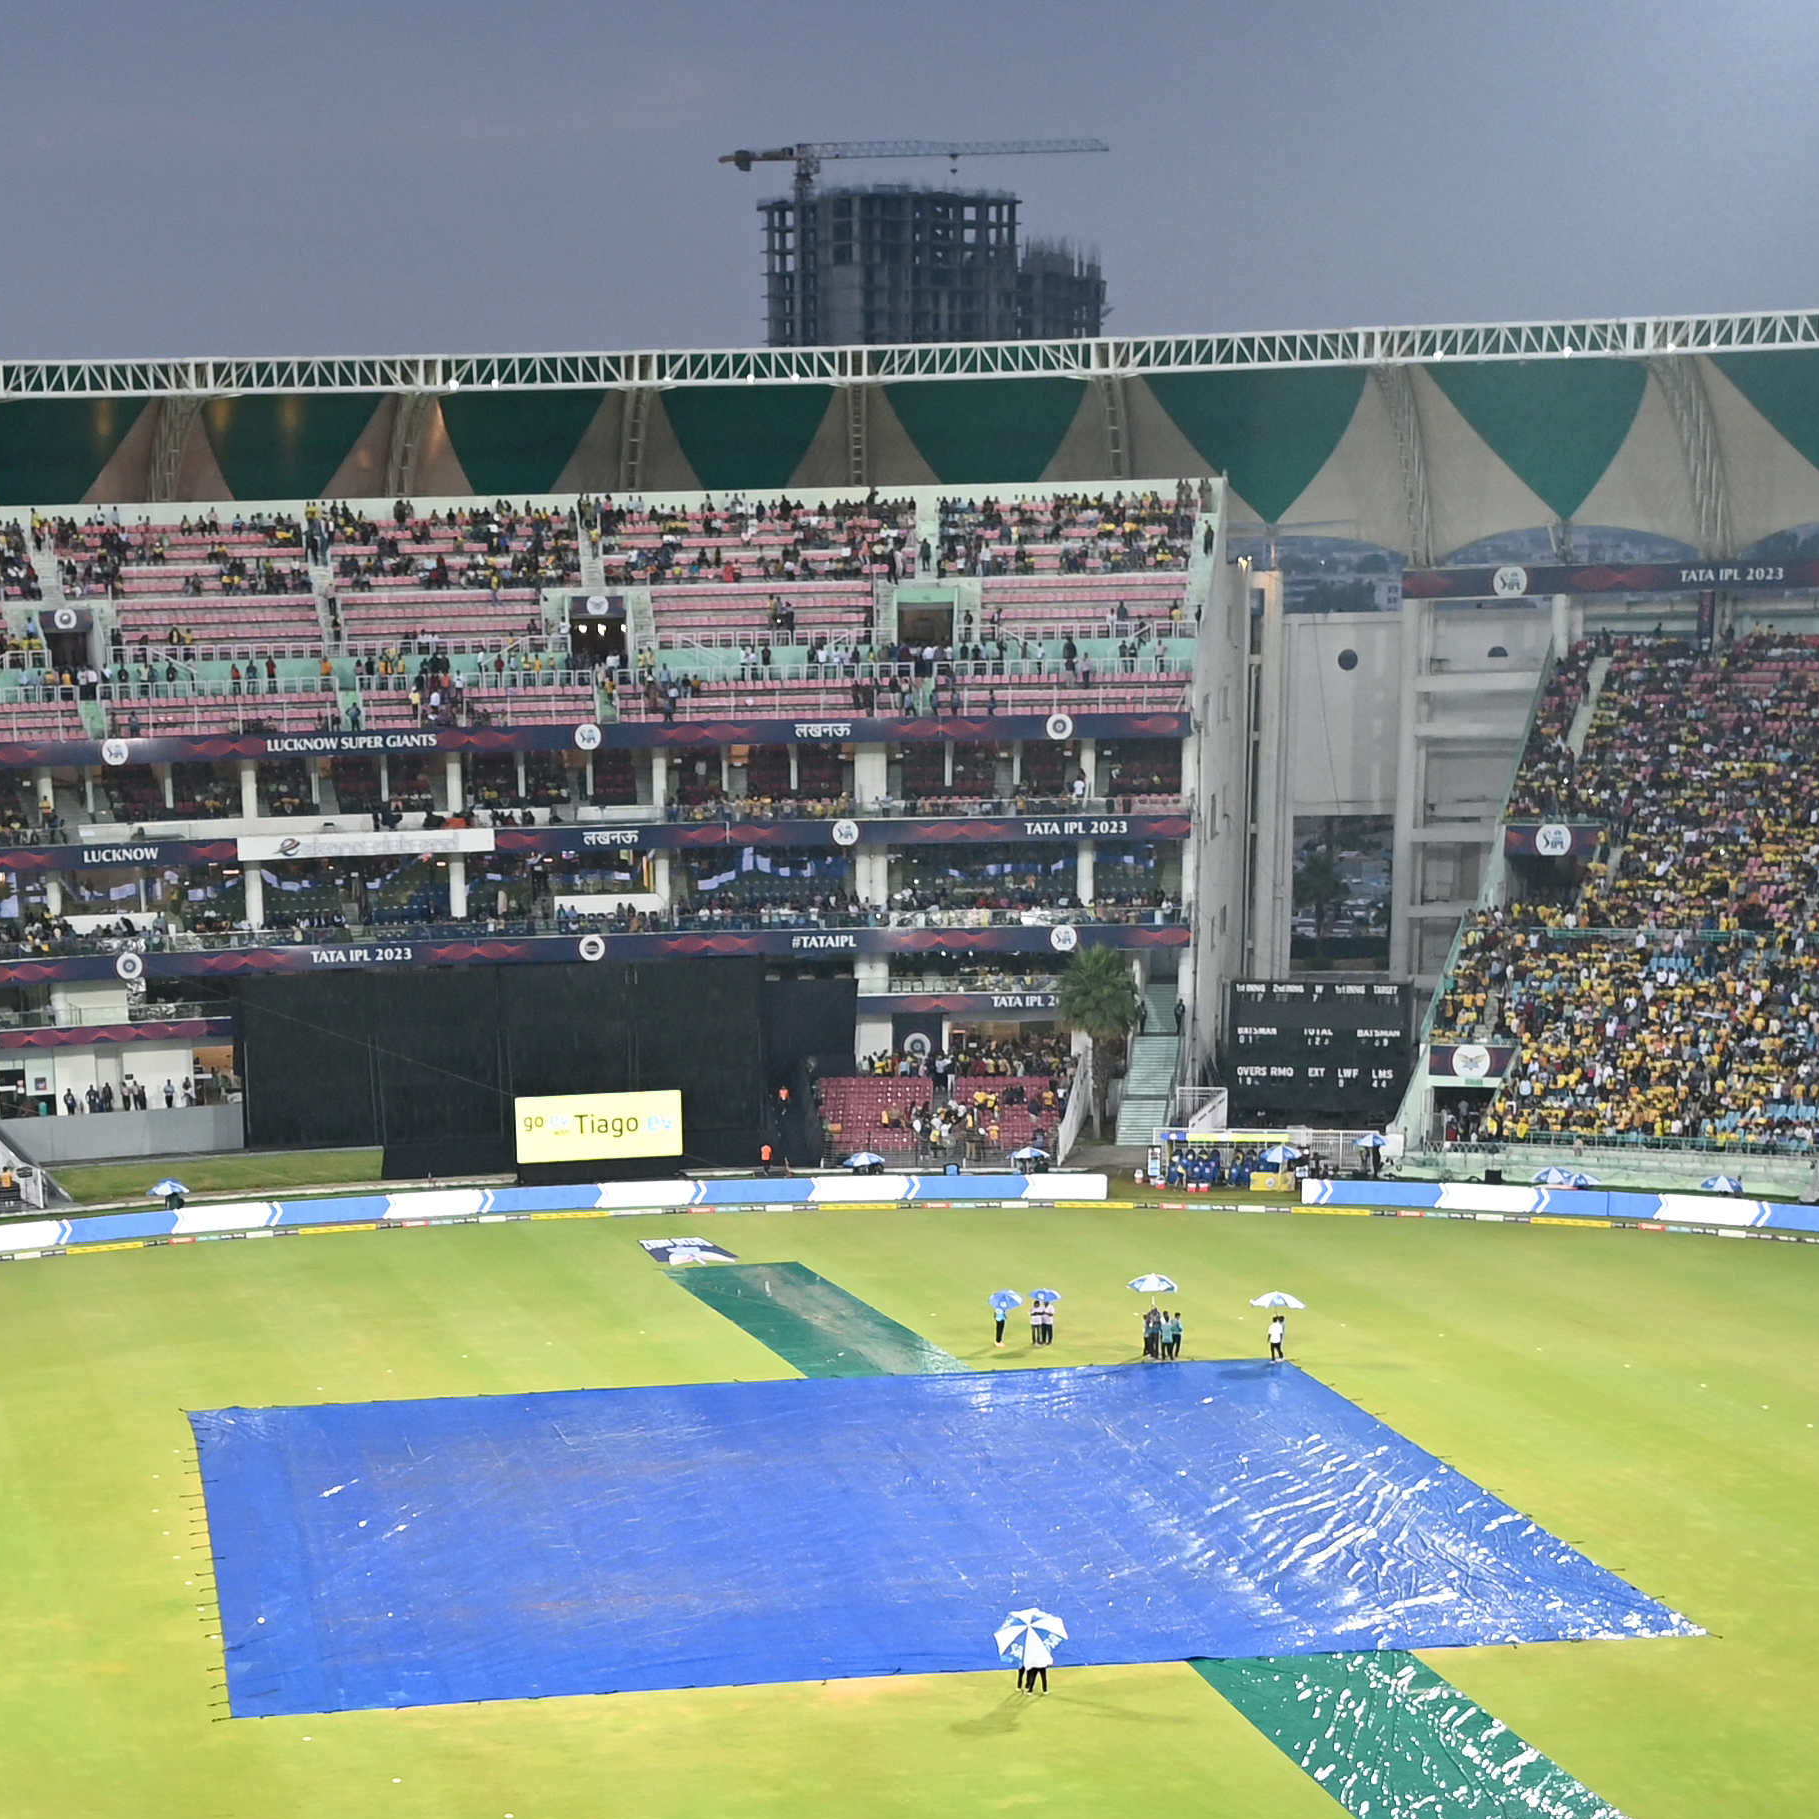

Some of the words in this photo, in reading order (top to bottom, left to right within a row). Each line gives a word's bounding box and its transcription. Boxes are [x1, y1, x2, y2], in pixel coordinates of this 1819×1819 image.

[1681, 569, 1714, 582] TATA
[1719, 568, 1741, 582] IPL
[1745, 567, 1784, 581] 2023
[794, 722, 851, 739] लखनऊ
[267, 736, 338, 752] LUCKNOW
[341, 735, 383, 750] SUPER
[386, 734, 437, 748] GIANTS
[1025, 822, 1060, 835] TATA
[1064, 821, 1087, 835] IPL
[1090, 819, 1128, 834] 2023
[583, 831, 639, 848] लखनऊ
[83, 847, 159, 864] LUCKNOW
[792, 934, 857, 949] #TATAIPL
[311, 950, 346, 964] TATA
[348, 948, 372, 962] IPL
[374, 947, 412, 961] 2023
[991, 995, 1023, 1008] TATA
[1025, 995, 1045, 1007] IPL
[1237, 1066, 1267, 1077] OVERS
[1270, 1067, 1295, 1077] RMO
[1308, 1067, 1325, 1077] EXT
[1372, 1069, 1394, 1080] LMS
